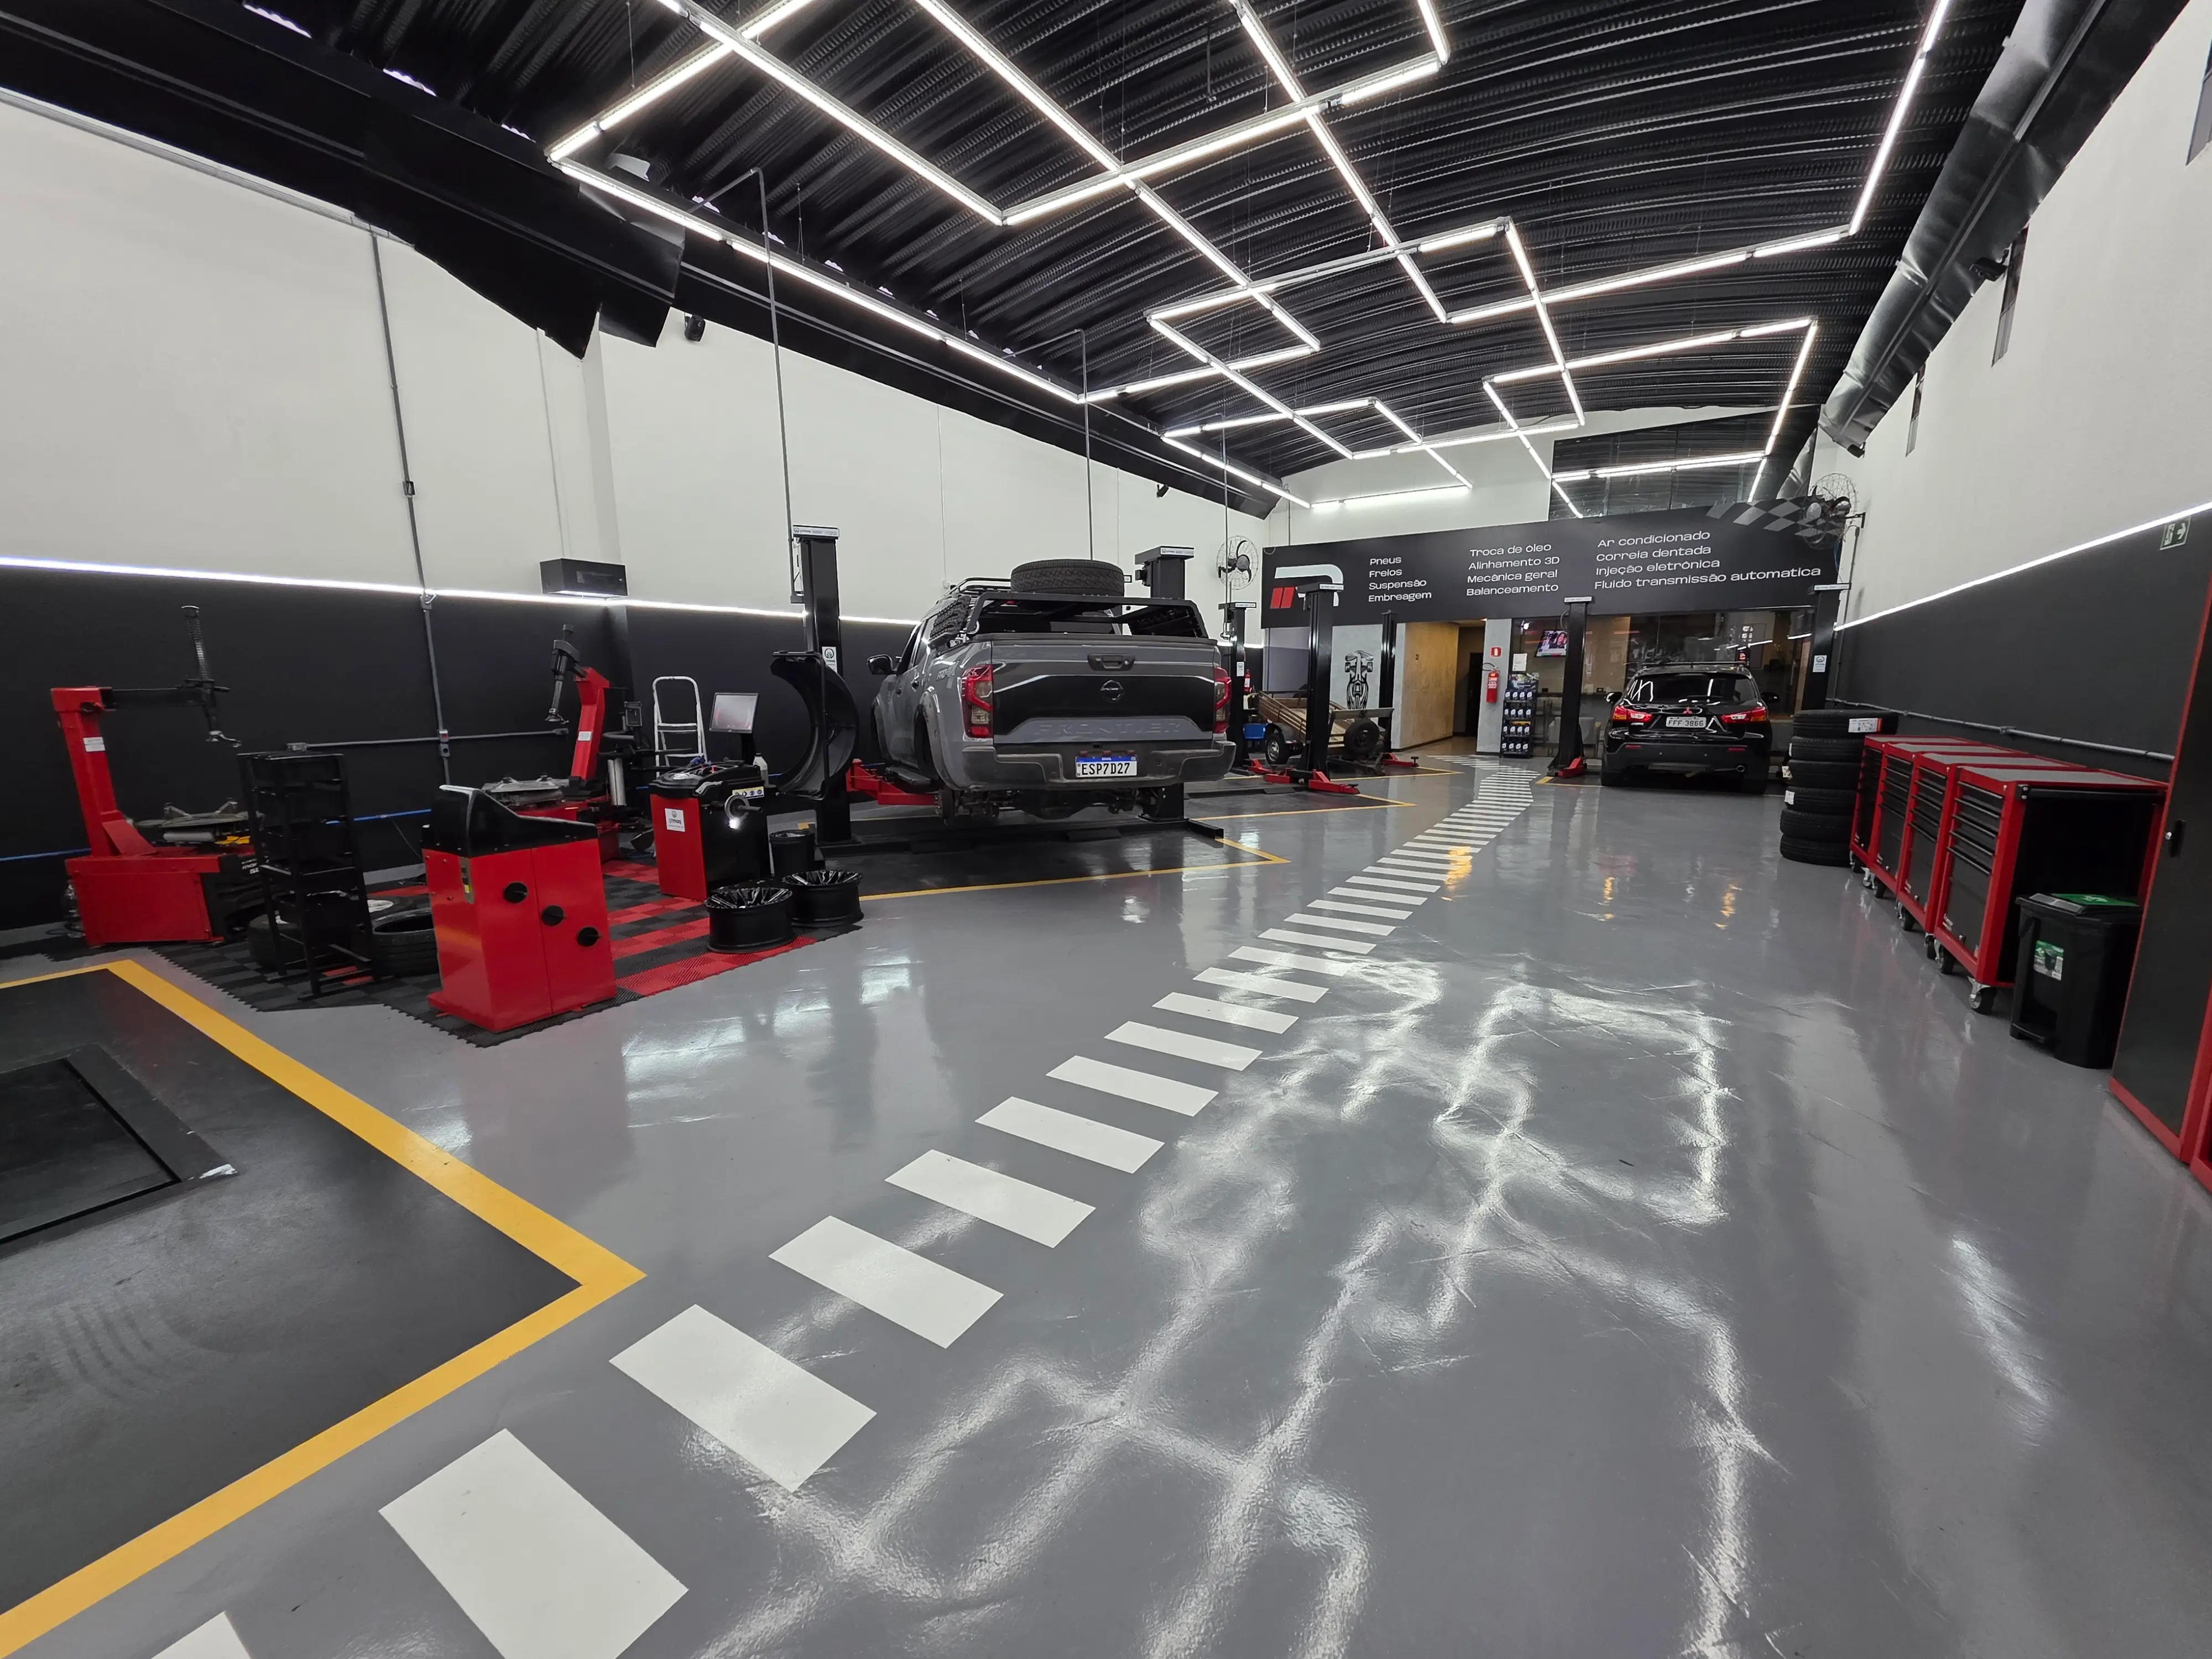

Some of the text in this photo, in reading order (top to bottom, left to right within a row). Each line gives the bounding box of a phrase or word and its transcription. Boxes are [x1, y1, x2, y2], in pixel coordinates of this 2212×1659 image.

[1597, 530, 1710, 547] Ar condicionado
[1469, 543, 1552, 557] Troca de óleo
[1596, 545, 1711, 562] Correia dentada
[1370, 556, 1402, 566] Pneus
[1468, 556, 1560, 570] Alinhamento 3D
[1369, 568, 1402, 578] Freios
[1596, 560, 1720, 577] Injeção eletrônica
[1467, 569, 1558, 583] Mecânica geral
[1594, 567, 1822, 589] Fluido transmissão automatica
[1369, 579, 1427, 591] Suspensão
[1466, 583, 1559, 596] Balanceamento
[1368, 592, 1432, 602] Embreagem
[1034, 723, 1180, 735] FRONTIER
[1082, 763, 1130, 775] ESP7D27
